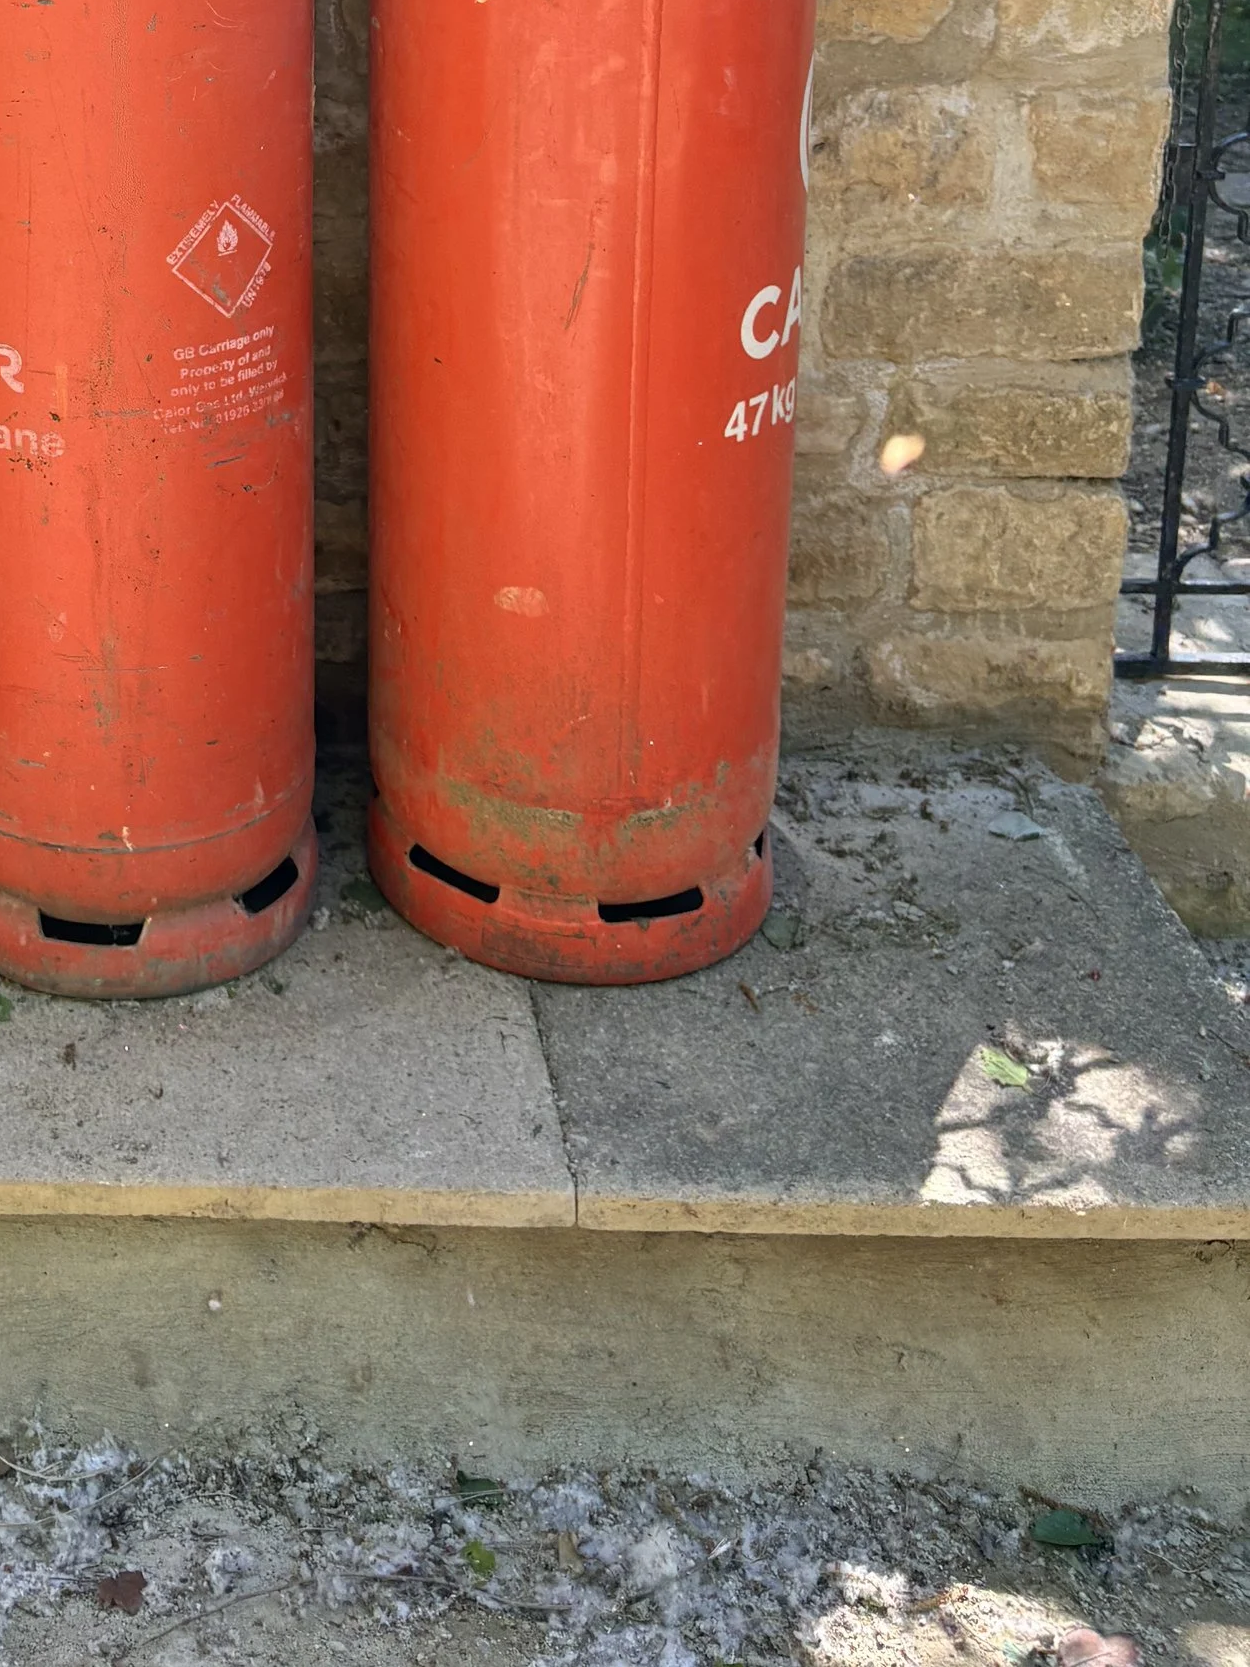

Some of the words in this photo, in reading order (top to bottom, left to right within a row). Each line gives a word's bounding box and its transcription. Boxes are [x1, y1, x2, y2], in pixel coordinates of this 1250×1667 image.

[166, 199, 220, 265] EXTREMELY
[231, 193, 276, 242] FLAMMABLE
[174, 346, 195, 361] GB
[198, 335, 250, 356] Carriage
[252, 325, 274, 342] only
[170, 382, 200, 397] only
[204, 380, 216, 391] to
[220, 375, 235, 387] be
[237, 362, 264, 382] filled
[266, 360, 278, 371] by
[180, 358, 235, 379] Property
[238, 352, 250, 366] of
[252, 345, 271, 361] and
